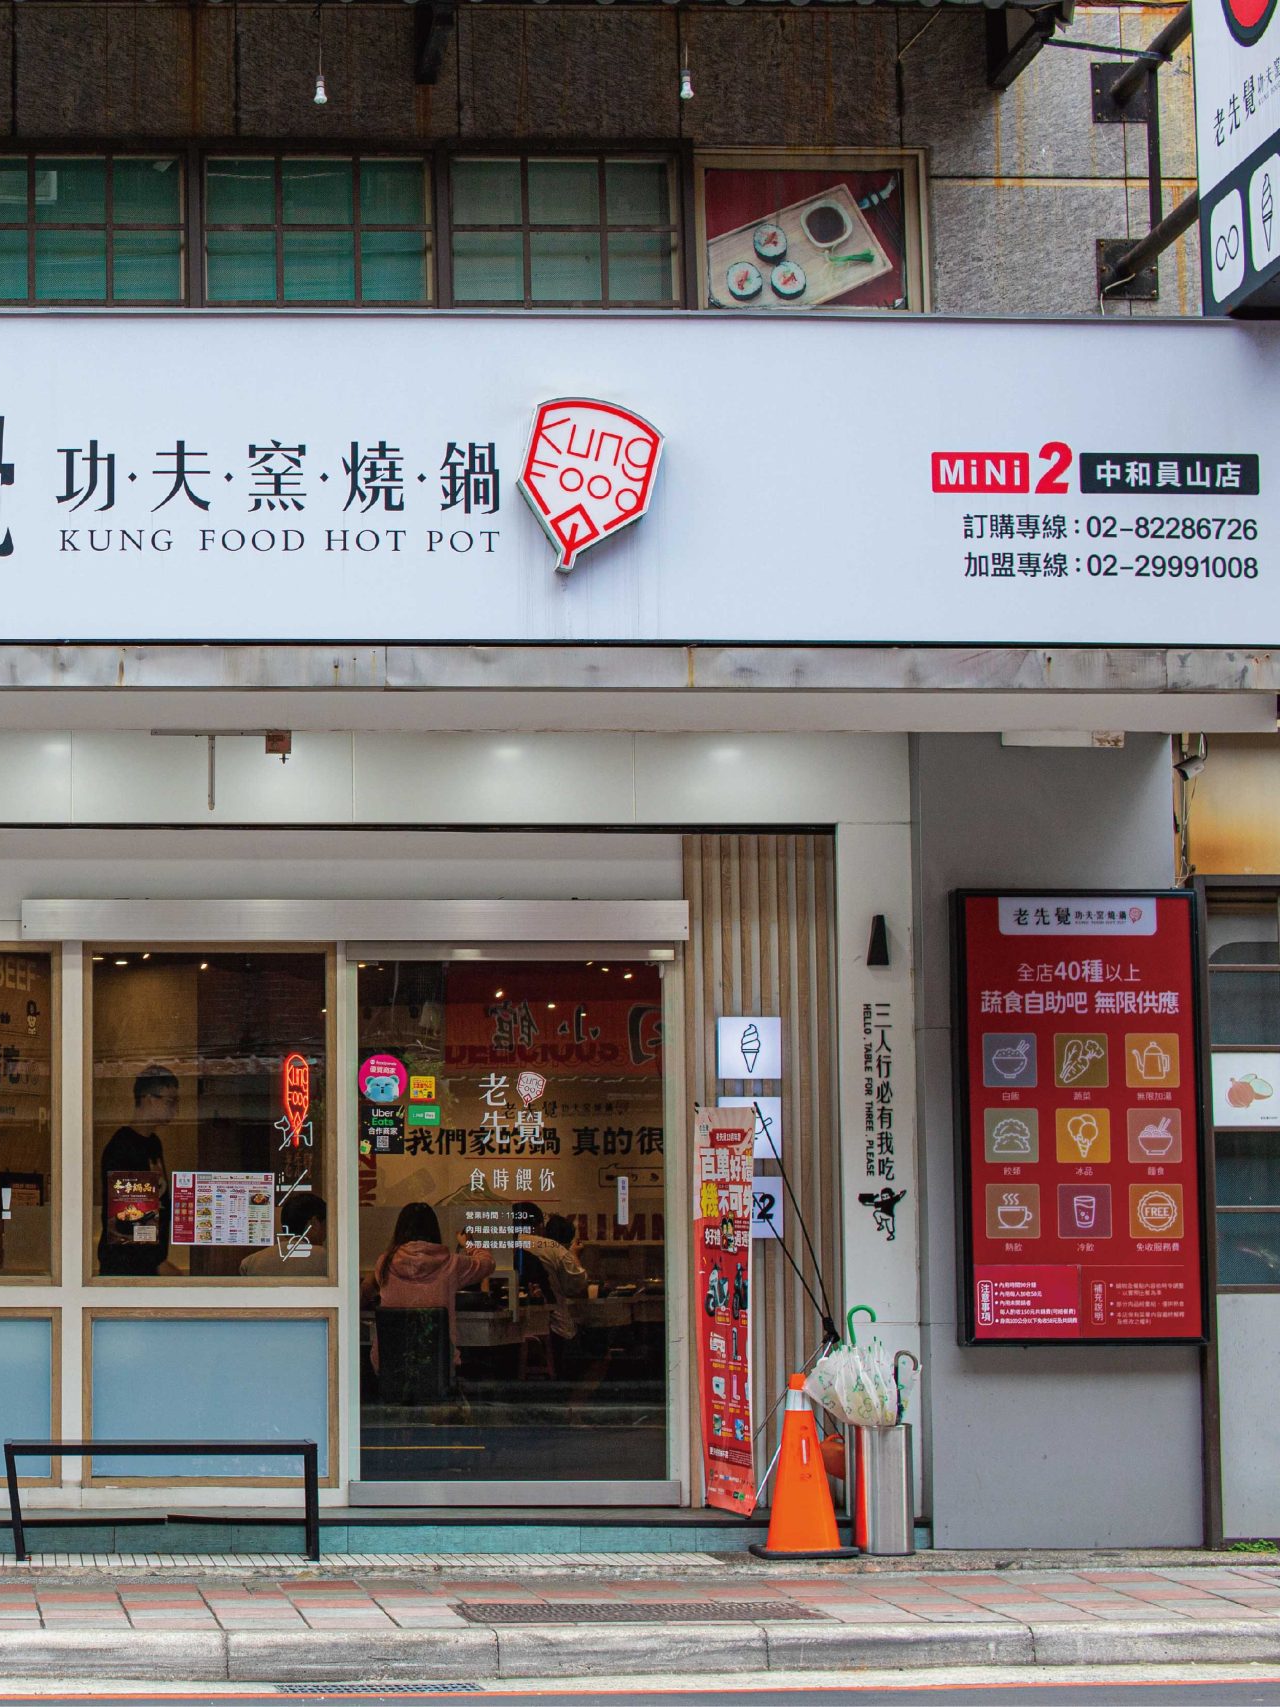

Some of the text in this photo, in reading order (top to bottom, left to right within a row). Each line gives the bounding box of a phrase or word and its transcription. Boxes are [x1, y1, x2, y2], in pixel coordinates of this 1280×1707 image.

[1035, 441, 1072, 494] 2
[1096, 460, 1241, 488] 中和員山店
[59, 529, 501, 554] KUNG FOOD HOT POT
[1013, 907, 1071, 925] 老先覺
[1017, 959, 1141, 983] 全店40種以上
[981, 991, 1179, 1014] 蔬食自助吧 無限供應
[863, 1042, 873, 1072] TABLE
[864, 1077, 873, 1096] FOR
[873, 1003, 895, 1181] 三人行必有我吃
[371, 1108, 394, 1118] Uber
[371, 1117, 394, 1126] Eats
[368, 1127, 398, 1136] 合作商家
[865, 1140, 875, 1176] PLEASE
[470, 1168, 556, 1192] 食時餵你
[1144, 1207, 1169, 1217] FREE
